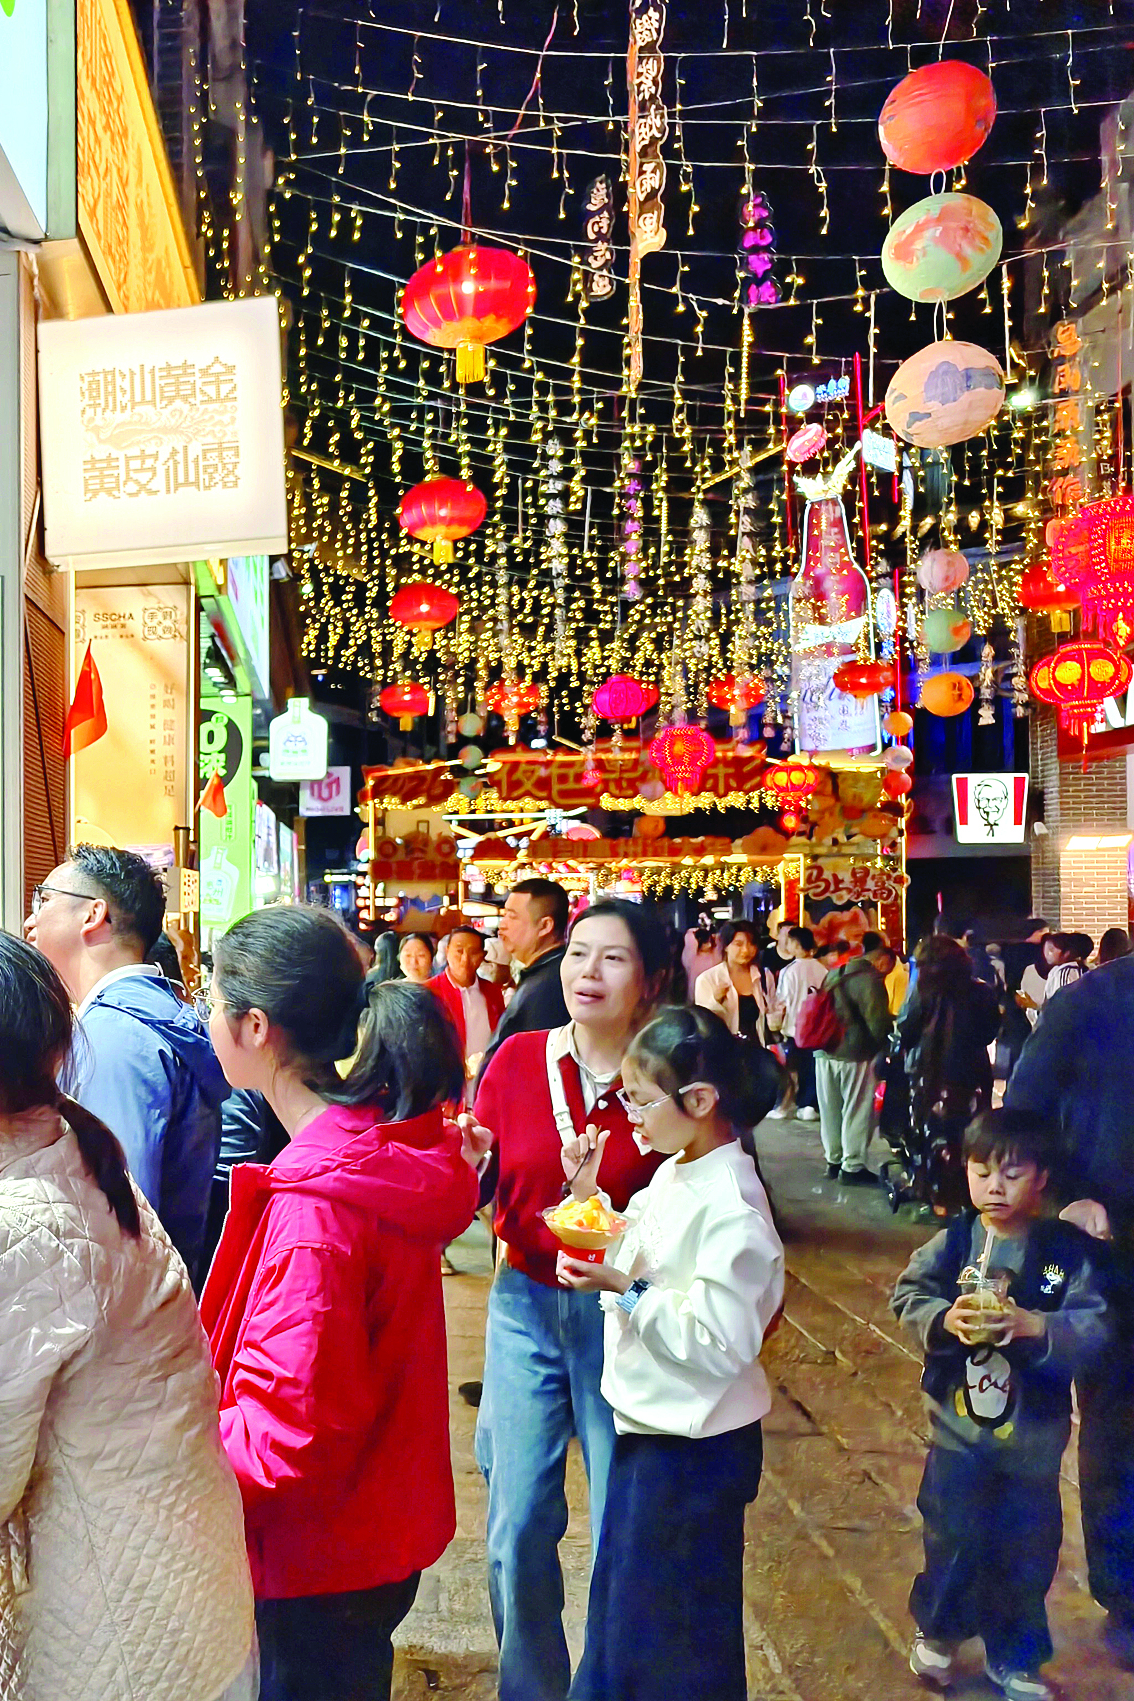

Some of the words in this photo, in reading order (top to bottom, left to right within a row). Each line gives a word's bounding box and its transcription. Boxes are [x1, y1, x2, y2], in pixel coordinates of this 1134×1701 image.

[82, 441, 240, 502] 黄皮仙露
[93, 613, 134, 623] SSCHA
[492, 745, 766, 805] 夜色惠彩
